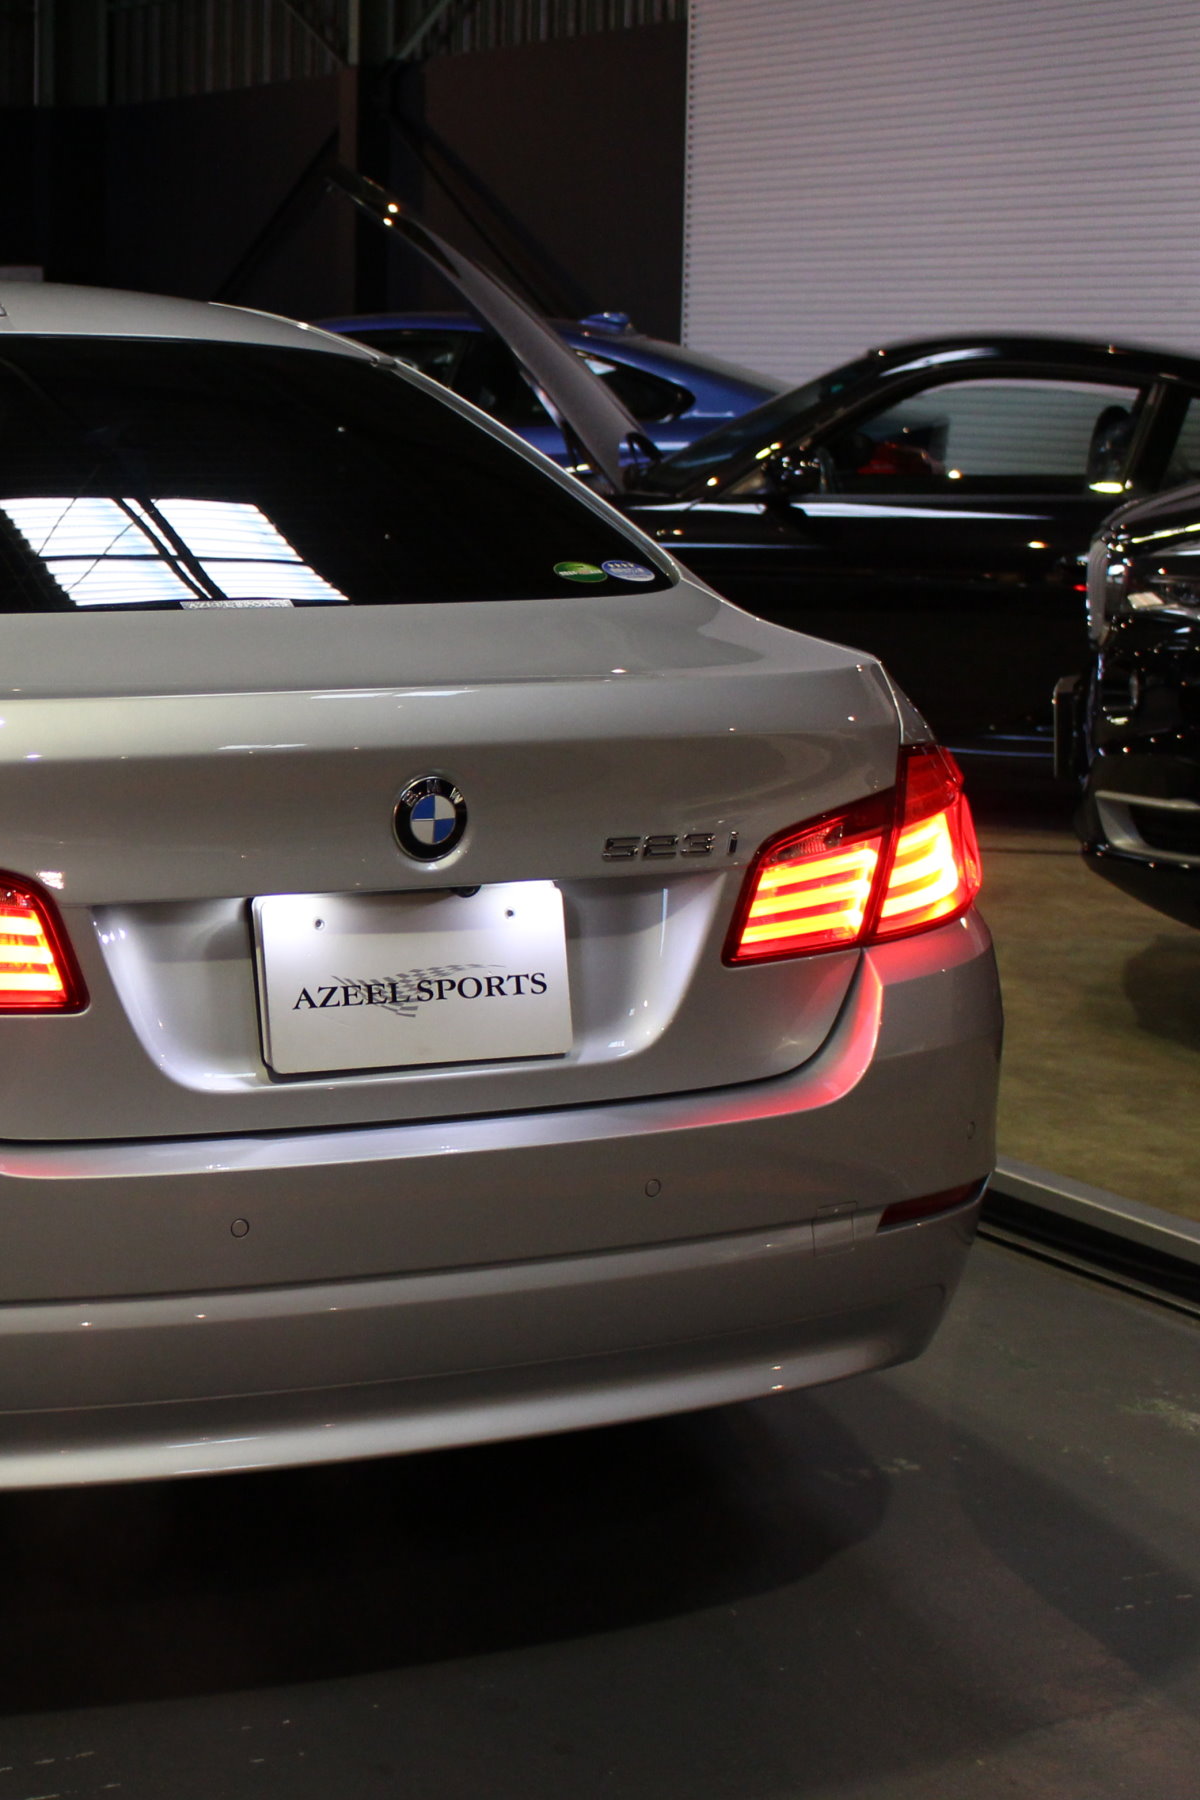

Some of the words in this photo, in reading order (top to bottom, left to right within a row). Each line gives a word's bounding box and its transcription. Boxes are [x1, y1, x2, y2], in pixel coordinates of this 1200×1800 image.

[402, 779, 463, 807] BMW
[292, 982, 411, 1010] AZEEL
[416, 972, 548, 1002] SPORTS
